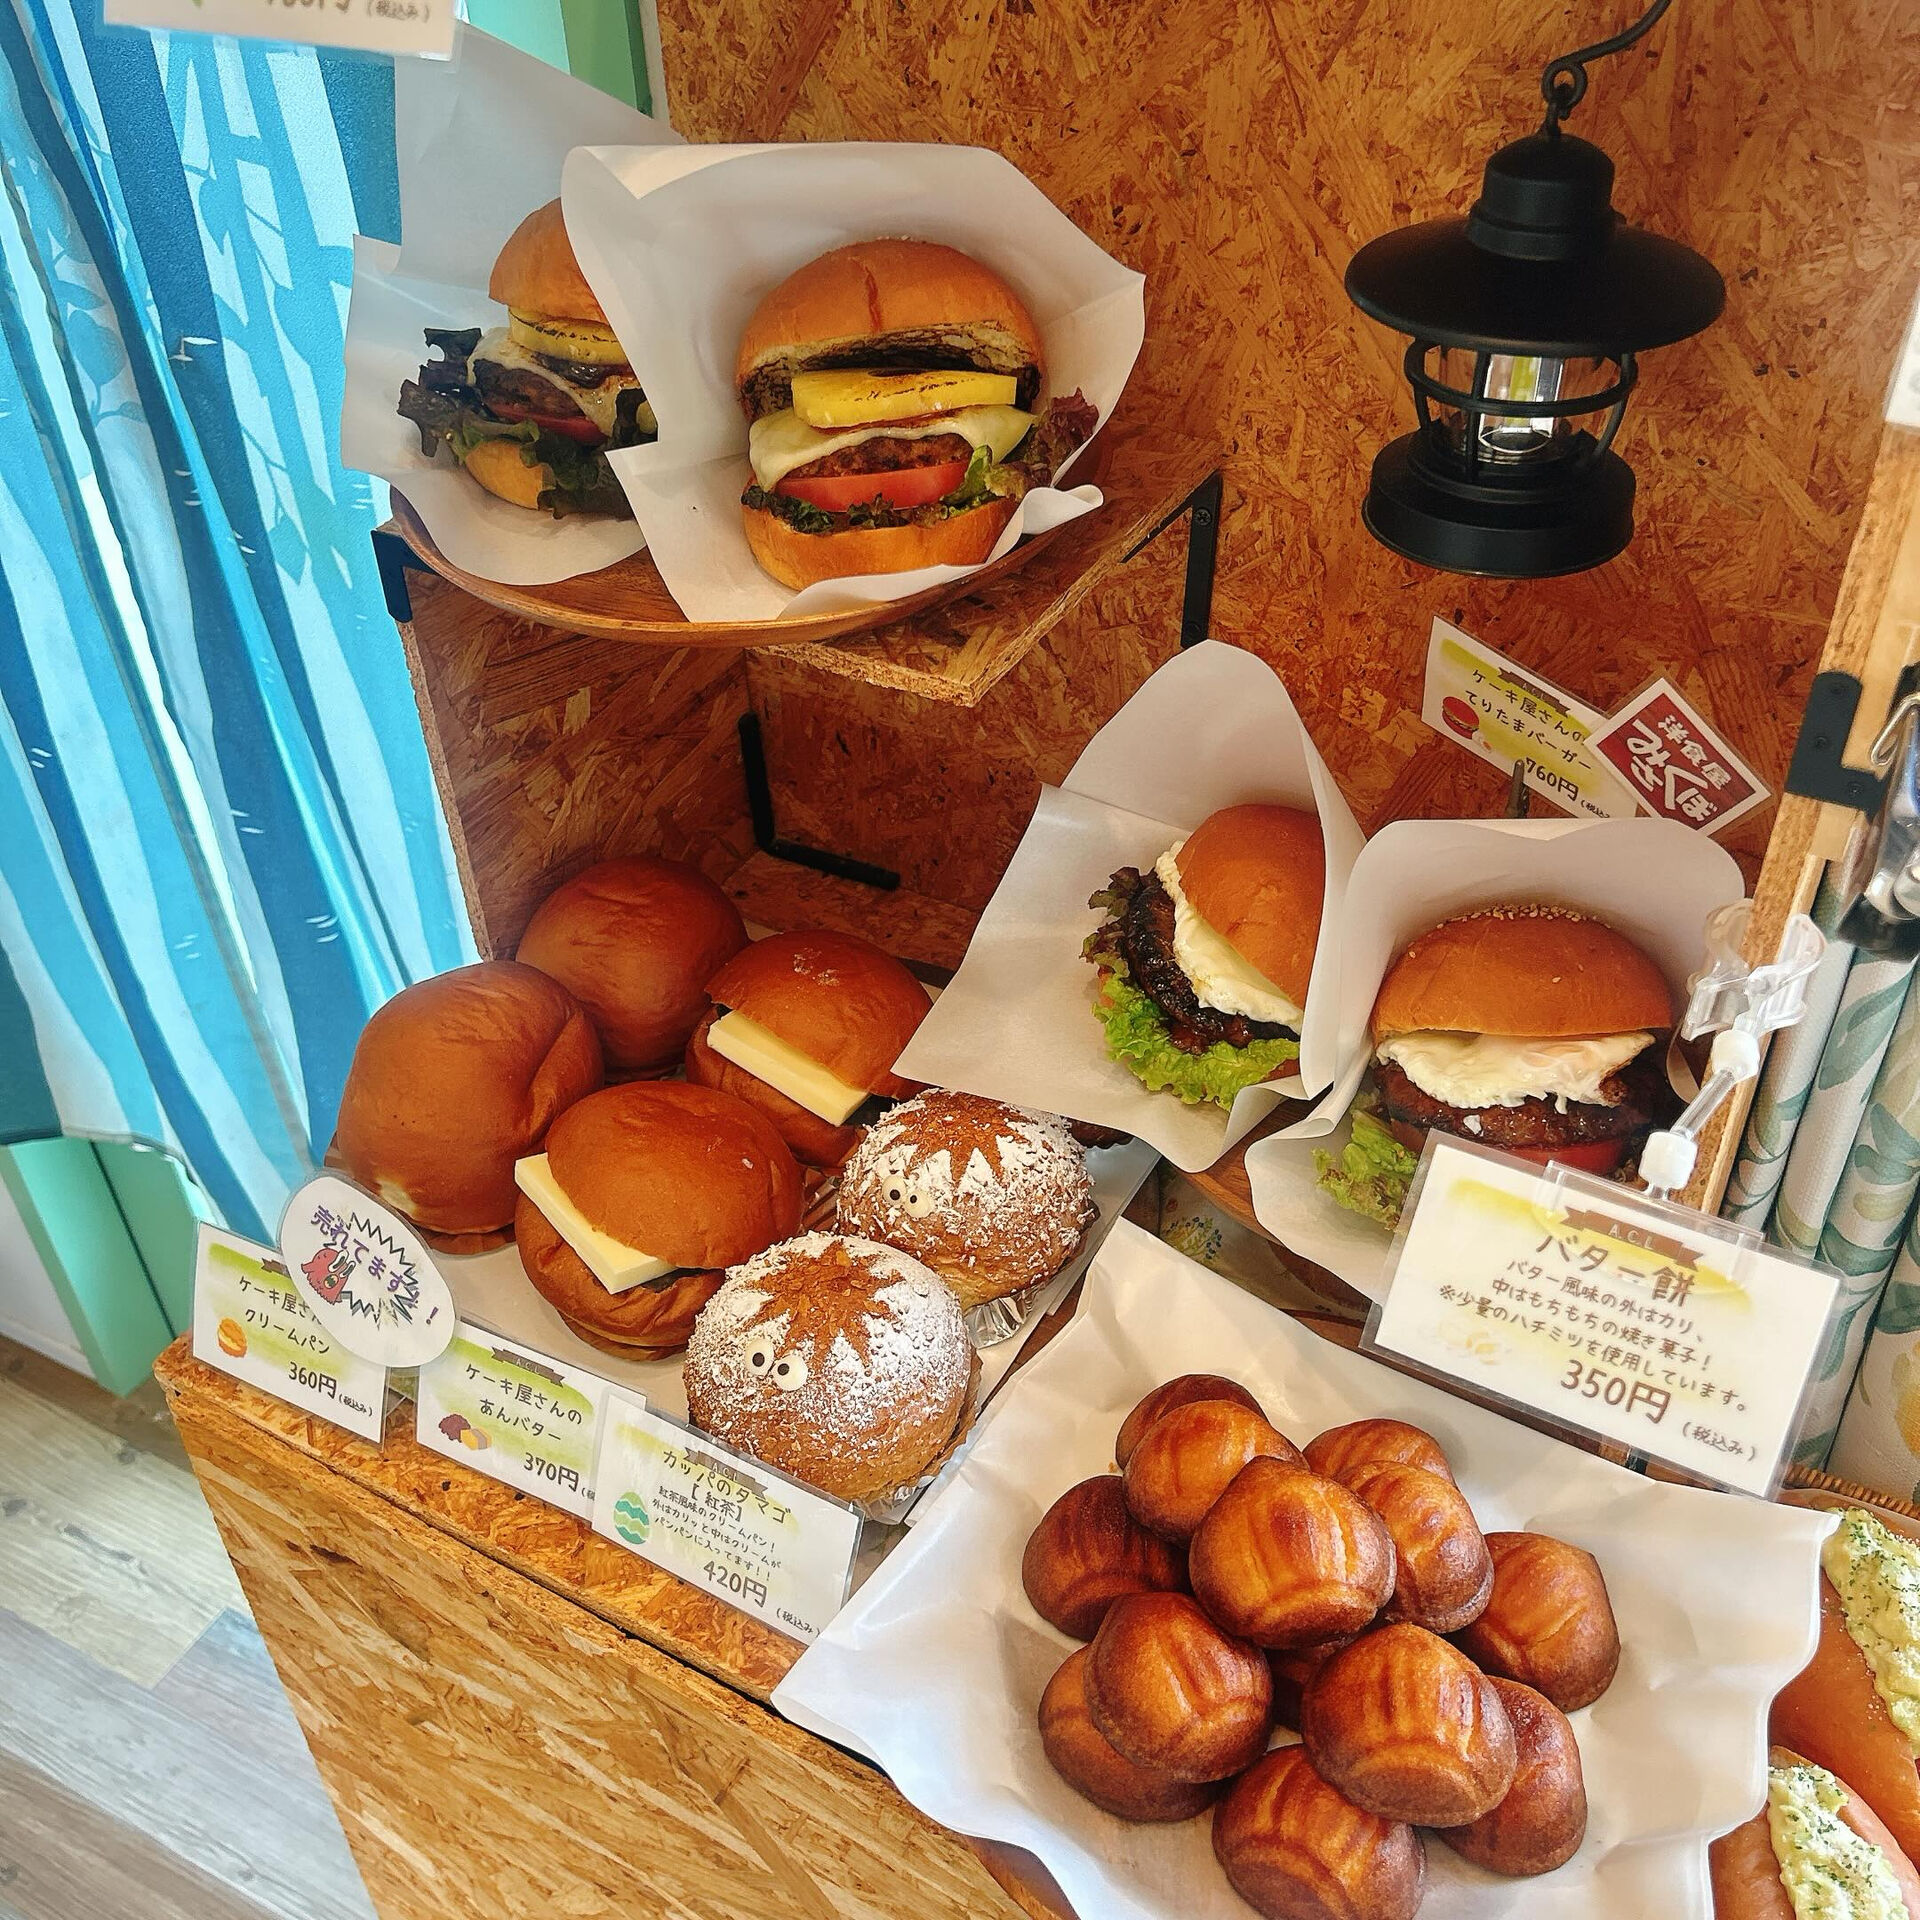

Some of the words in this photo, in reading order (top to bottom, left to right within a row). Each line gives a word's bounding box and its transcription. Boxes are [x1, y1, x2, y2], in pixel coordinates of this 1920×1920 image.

[1465, 690, 1591, 770] てりたまバーガー
[1658, 715, 1731, 790] 洋食屋
[1526, 757, 1579, 801] 760円
[1507, 1260, 1704, 1344] バター風味の外はカリ、
[1536, 1235, 1696, 1308] バター餅
[245, 1308, 329, 1354] クリームパン
[1491, 1278, 1712, 1371] 中はもちもちの焼き菓子!
[288, 1361, 337, 1399] 360円
[466, 1364, 582, 1425] ケーキ屋さんの
[1561, 1359, 1671, 1424] 350円
[1681, 1421, 1757, 1462] (税込み)
[480, 1398, 561, 1441] あんバター
[523, 1452, 579, 1492] 370円
[663, 1450, 791, 1523] カッパのタマゴ
[691, 1483, 743, 1522] 【紅茶】
[652, 1498, 781, 1569] 外はカリッと中はクリームが
[655, 1517, 770, 1581] パンパンに入ってます!!
[659, 1485, 775, 1553] 紅茶風味のクリームパン!
[703, 1560, 767, 1608] 420円
[776, 1608, 820, 1638] (税込み)
